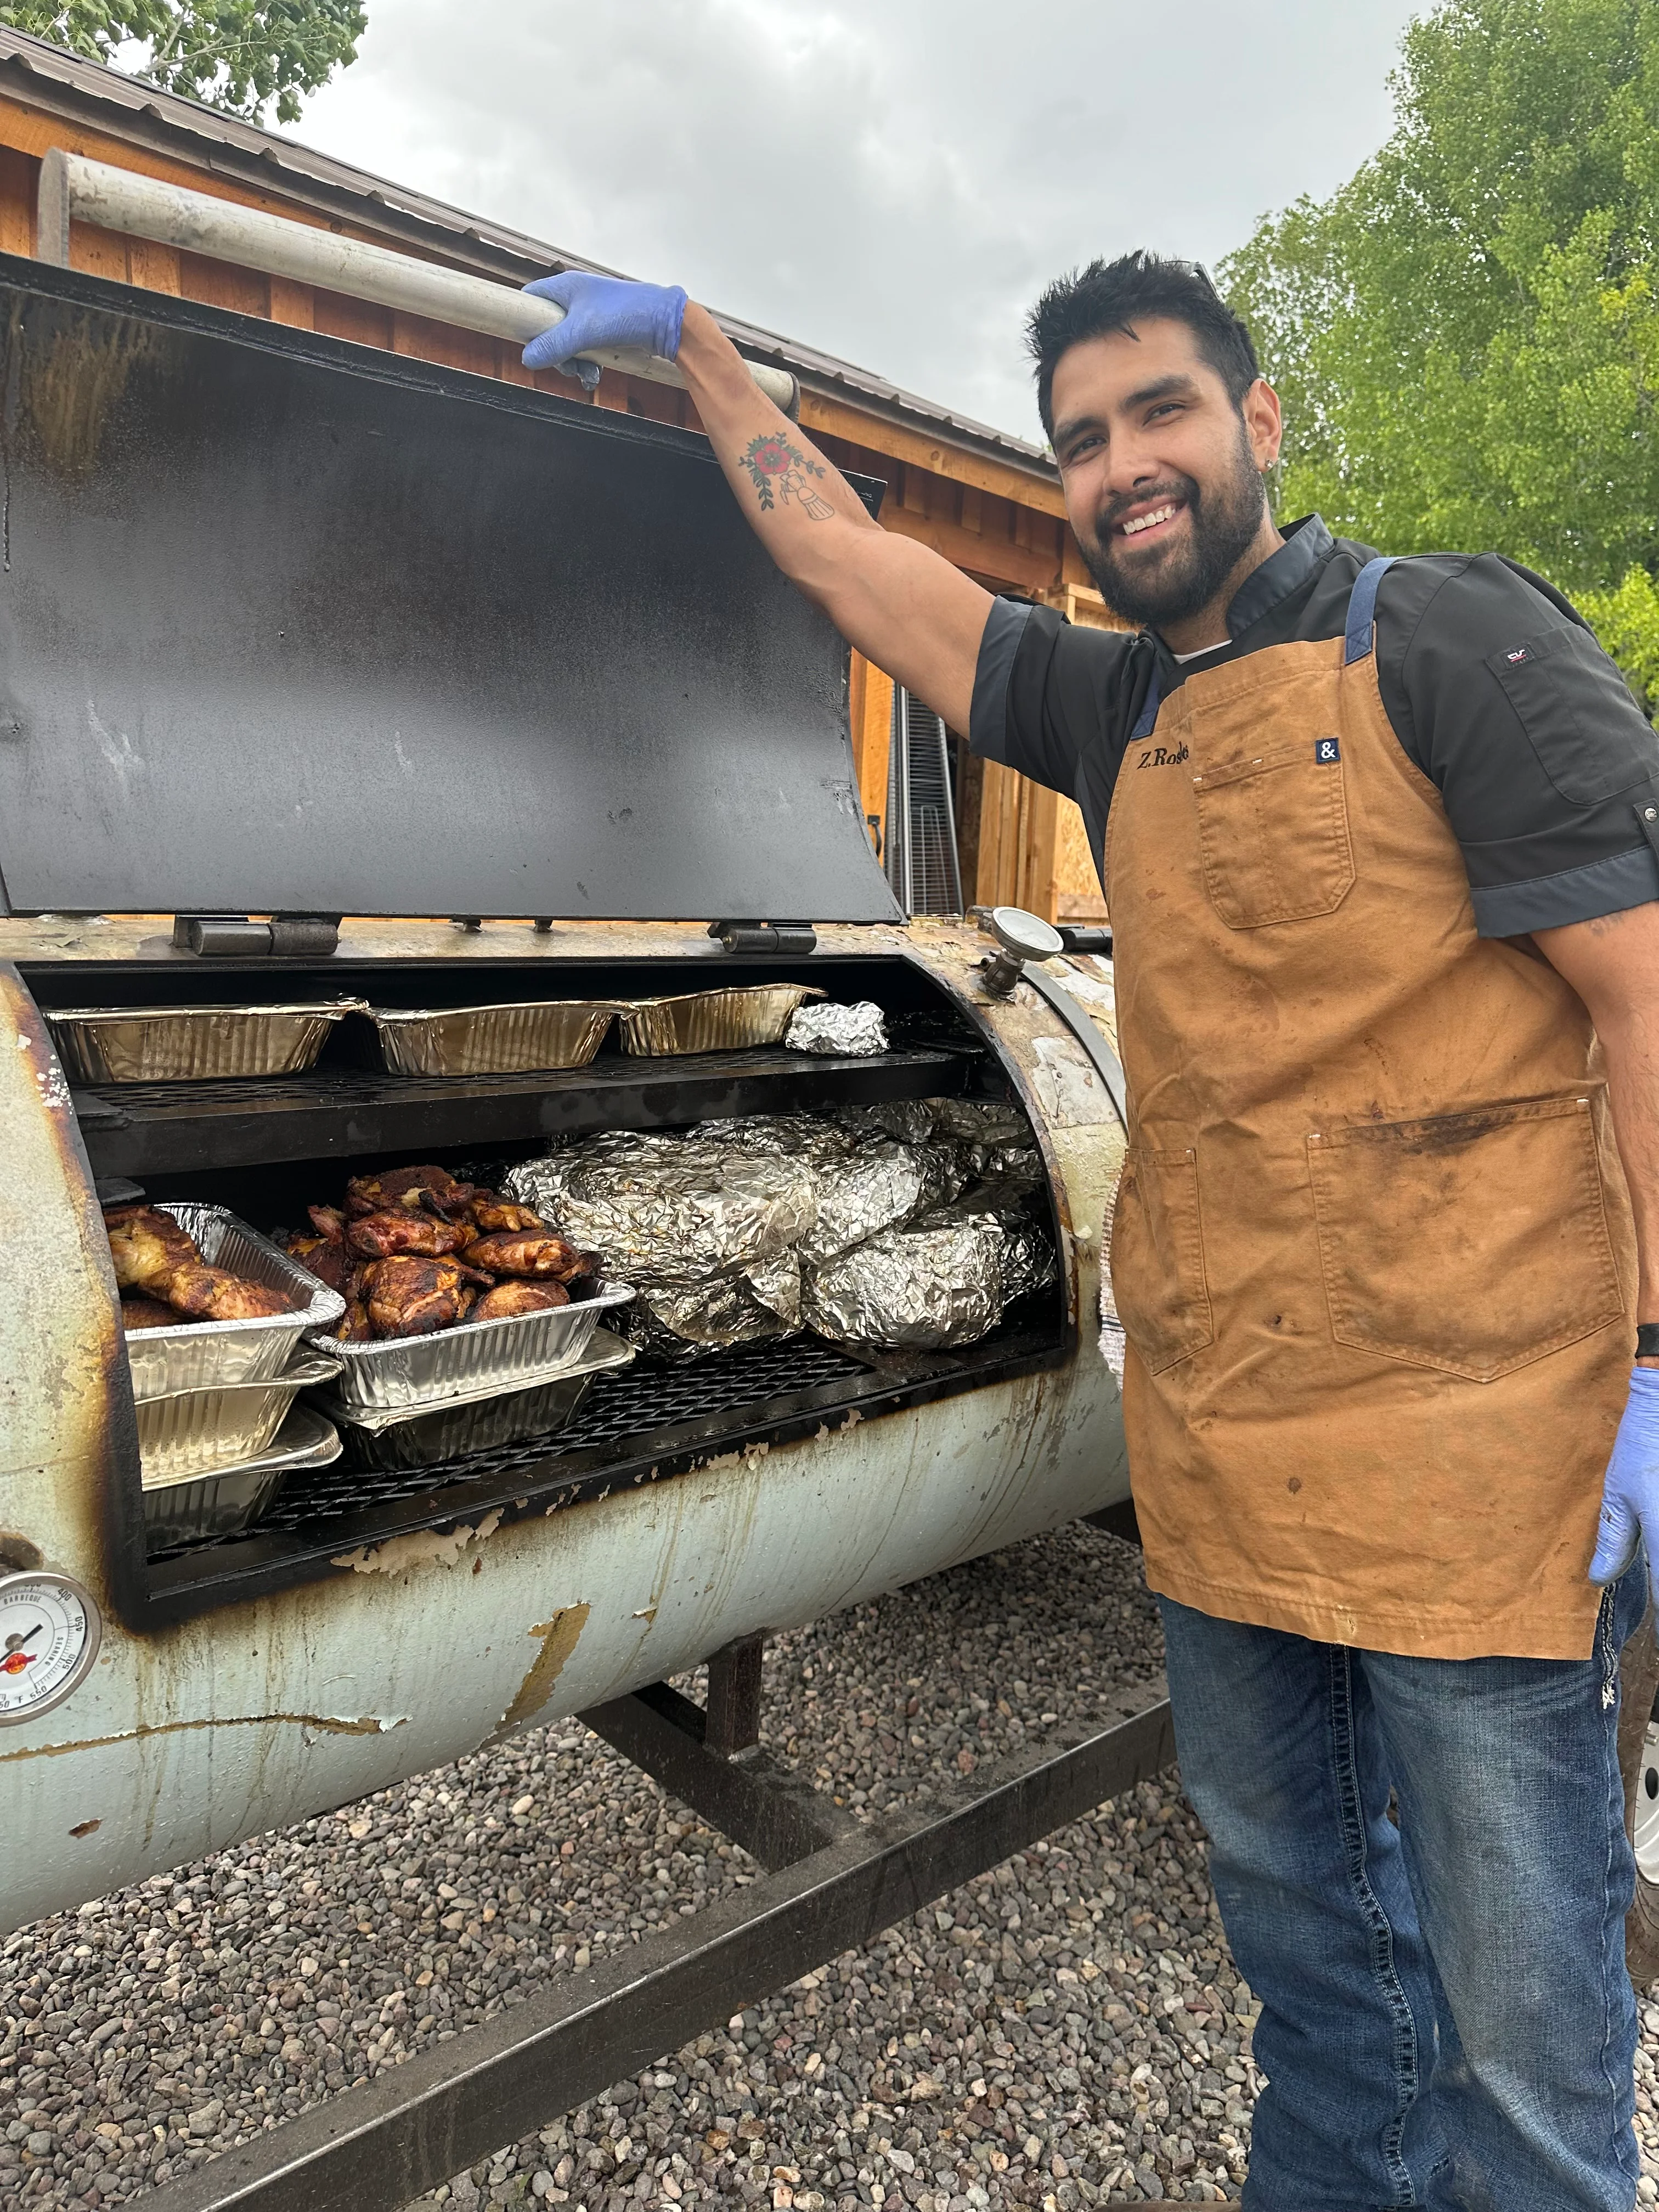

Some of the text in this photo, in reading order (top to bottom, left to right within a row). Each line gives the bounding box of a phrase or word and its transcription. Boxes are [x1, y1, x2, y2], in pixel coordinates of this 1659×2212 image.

[1321, 741, 1336, 759] &
[4, 1594, 42, 1605] BARBEQUE
[58, 1588, 72, 1601] 400
[75, 1616, 83, 1632] 450
[44, 1637, 64, 1666] SEARING
[63, 1654, 76, 1669] 500
[30, 1685, 47, 1700] 550
